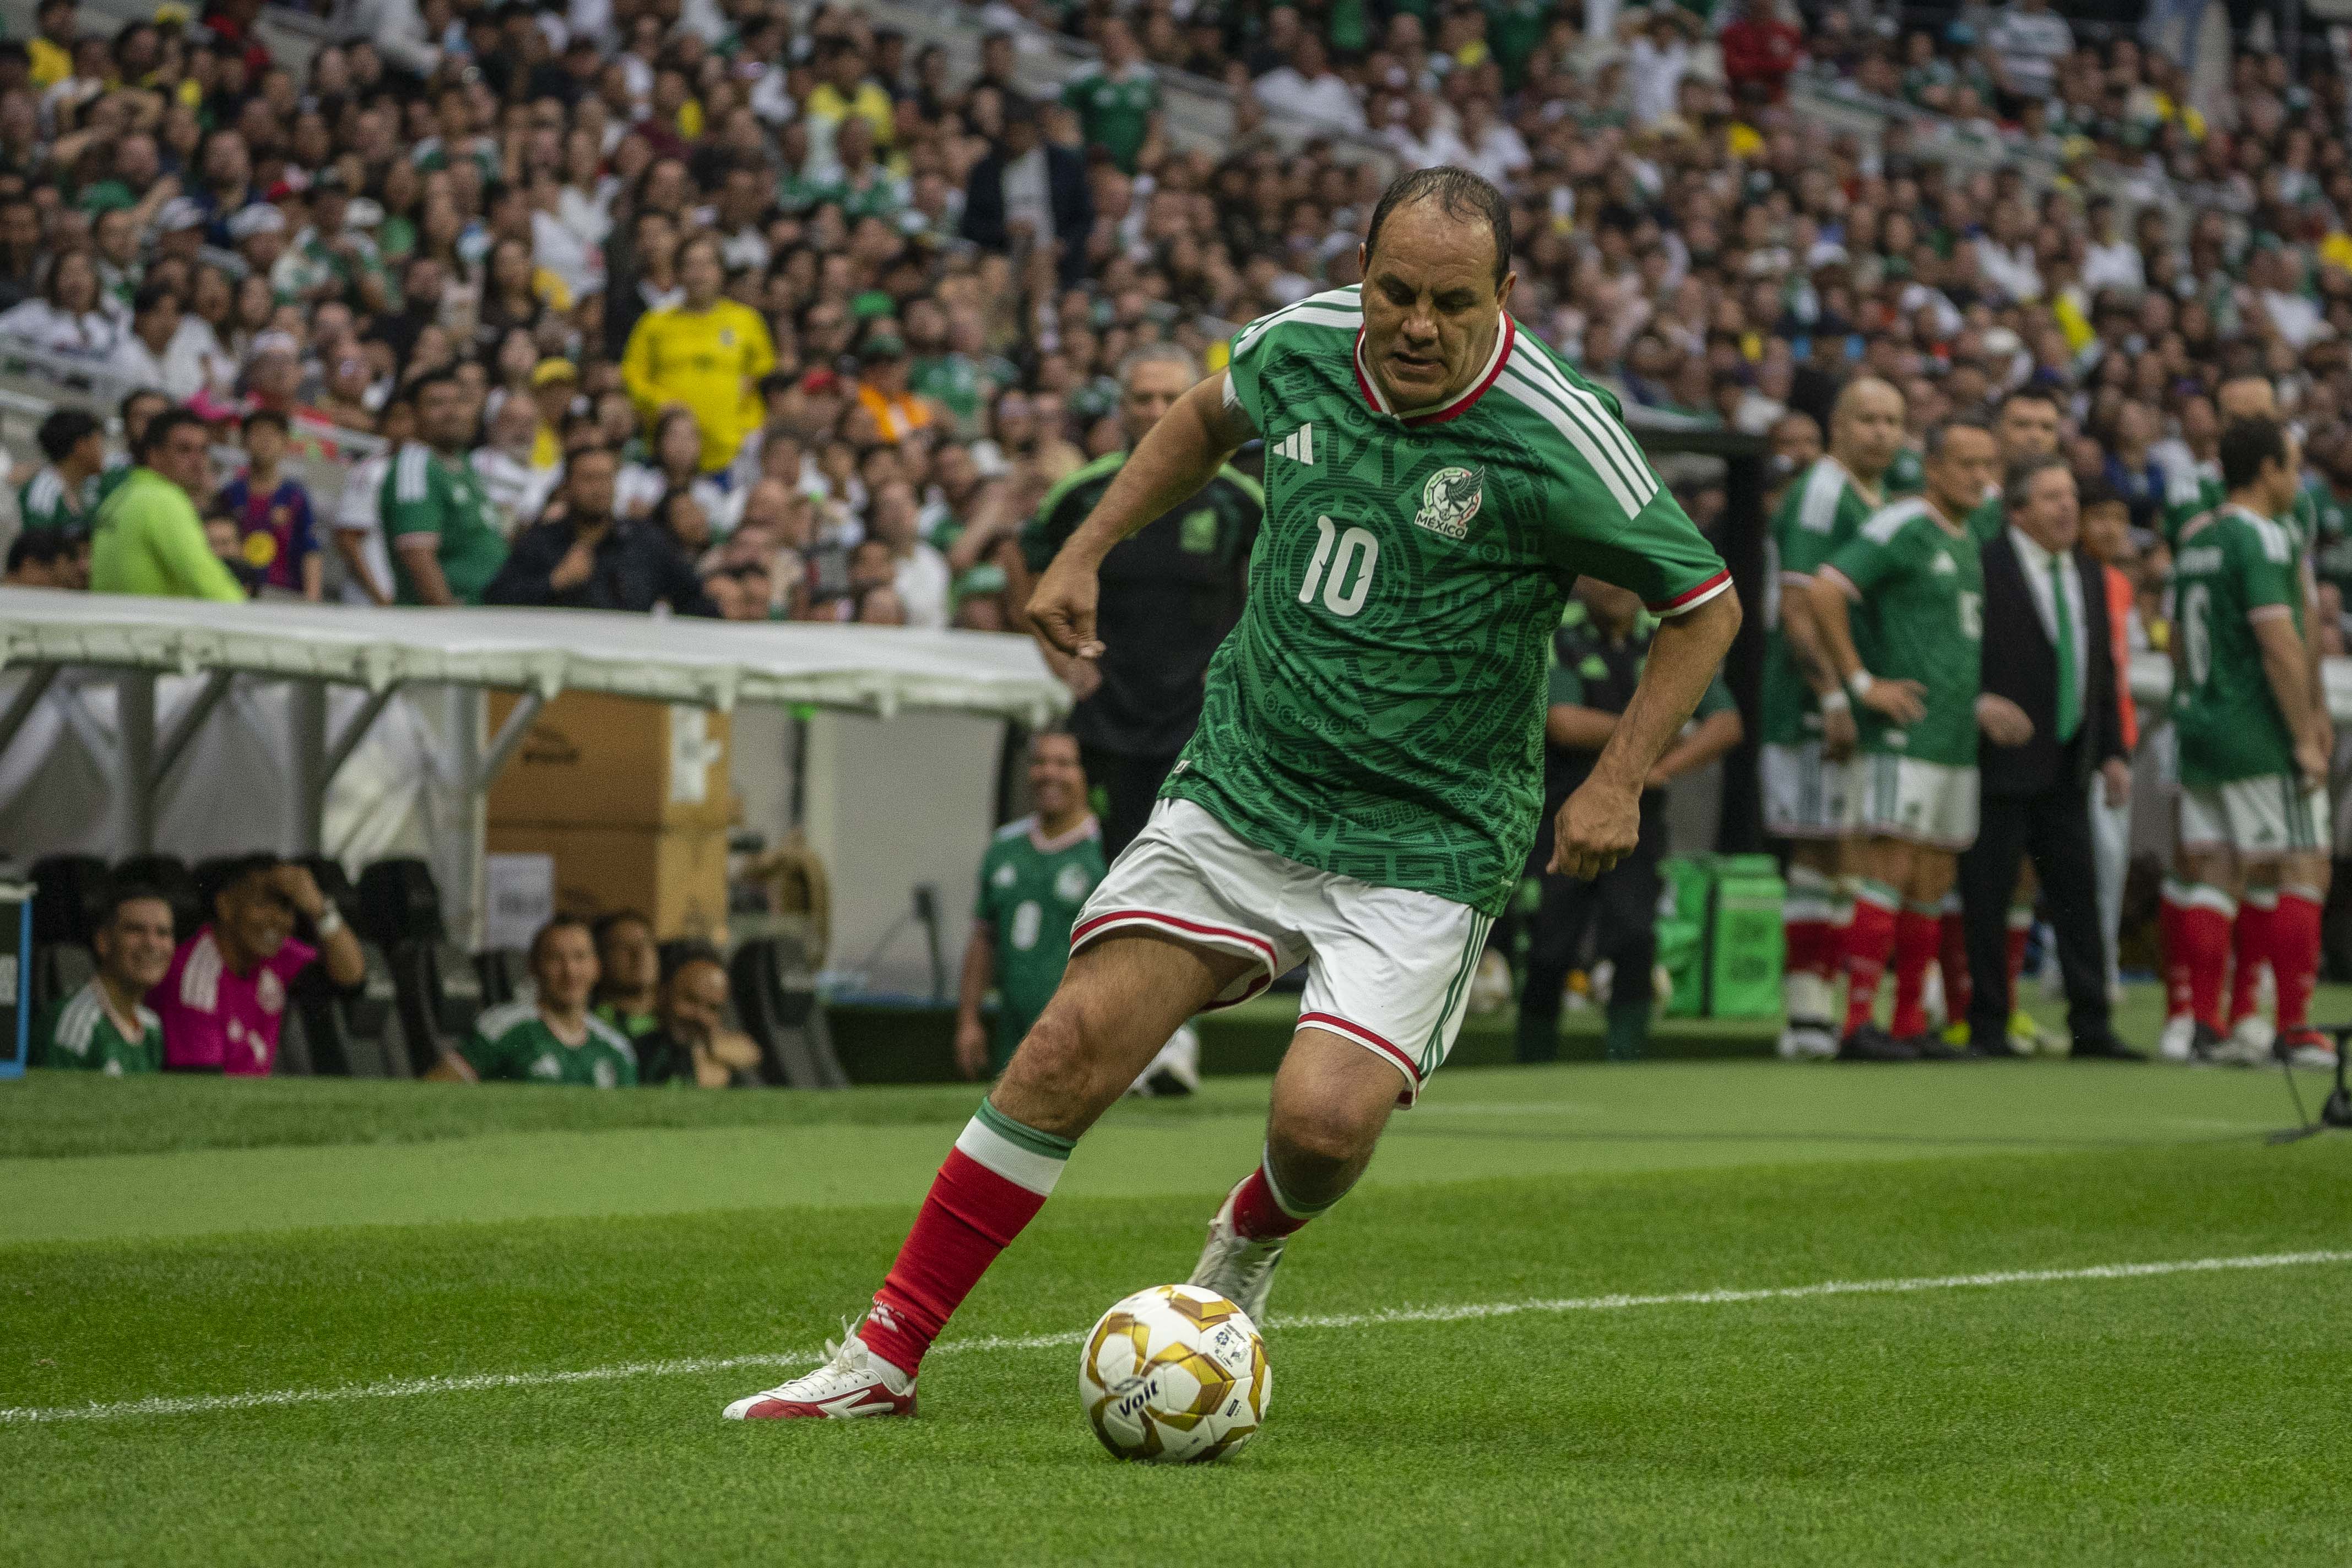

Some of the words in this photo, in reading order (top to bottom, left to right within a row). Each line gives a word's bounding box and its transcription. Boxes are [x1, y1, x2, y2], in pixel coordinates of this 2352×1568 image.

[1417, 513, 1465, 537] MÉXICO
[1298, 514, 1379, 616] 10
[1119, 1379, 1159, 1416] Voit
